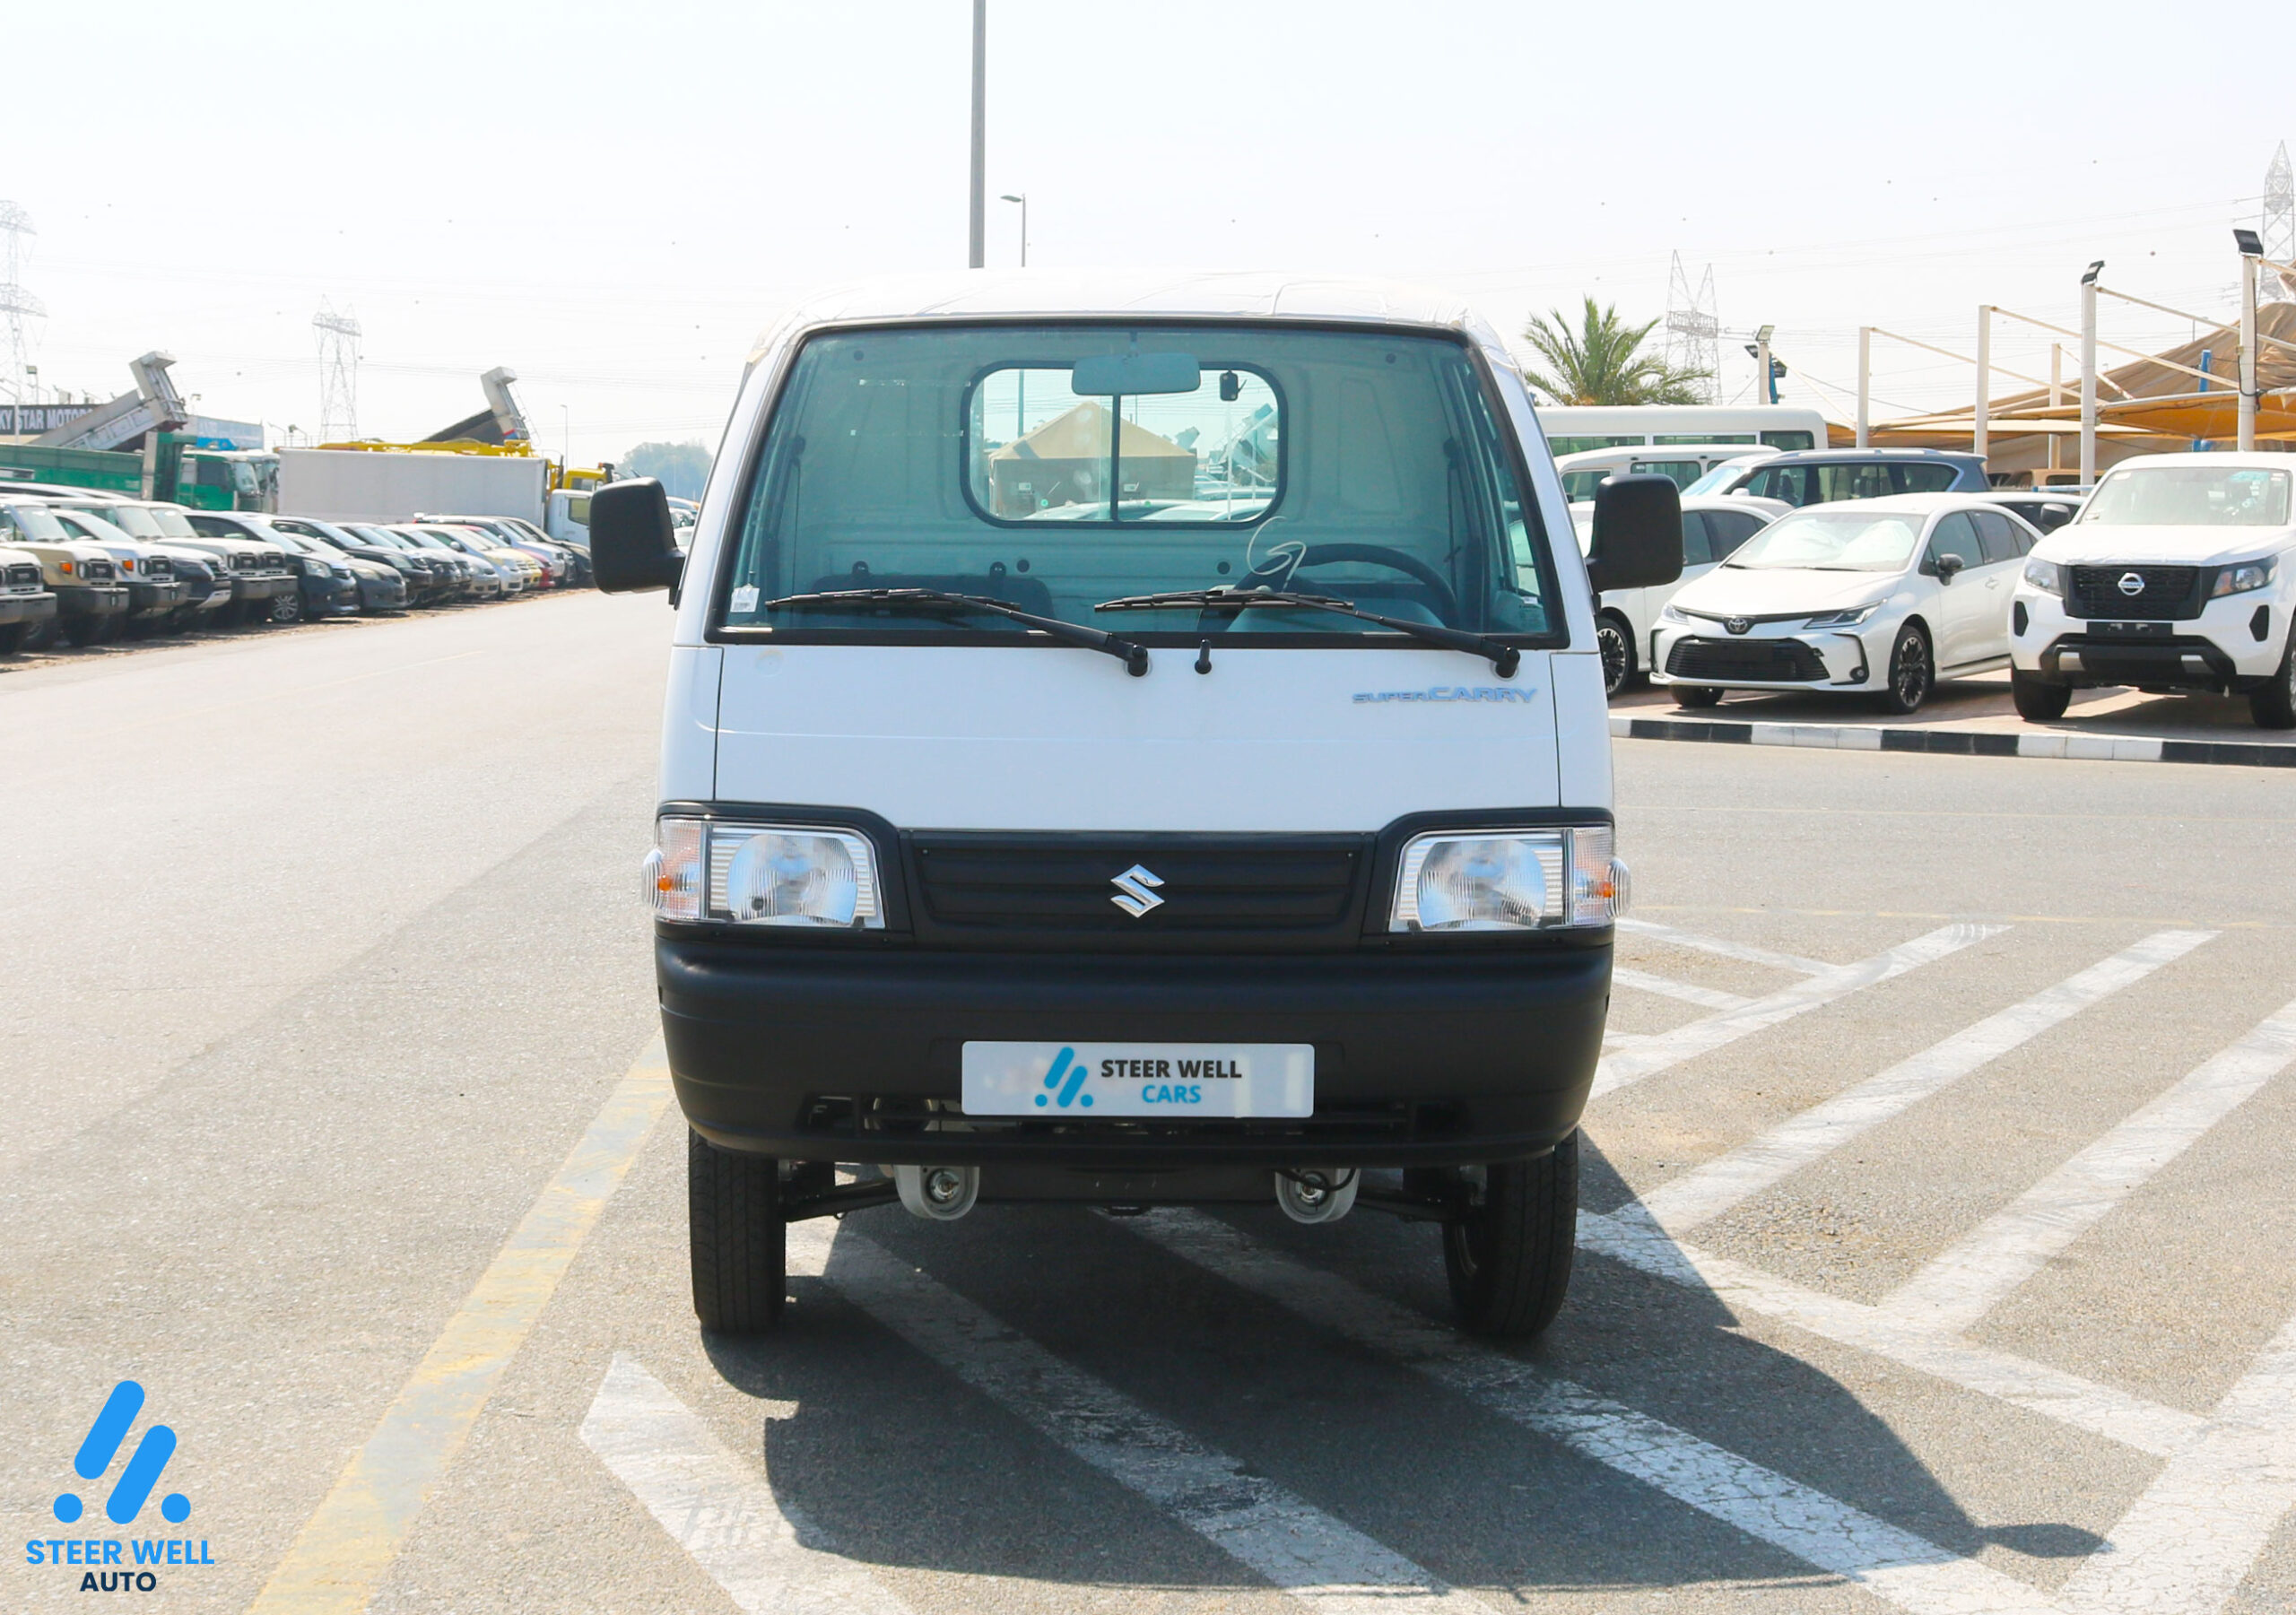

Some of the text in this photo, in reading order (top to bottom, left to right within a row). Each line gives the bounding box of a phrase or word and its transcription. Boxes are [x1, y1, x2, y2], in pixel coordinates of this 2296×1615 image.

[1100, 1059, 1242, 1079] STEER WELL
[1142, 1084, 1202, 1104] CARS
